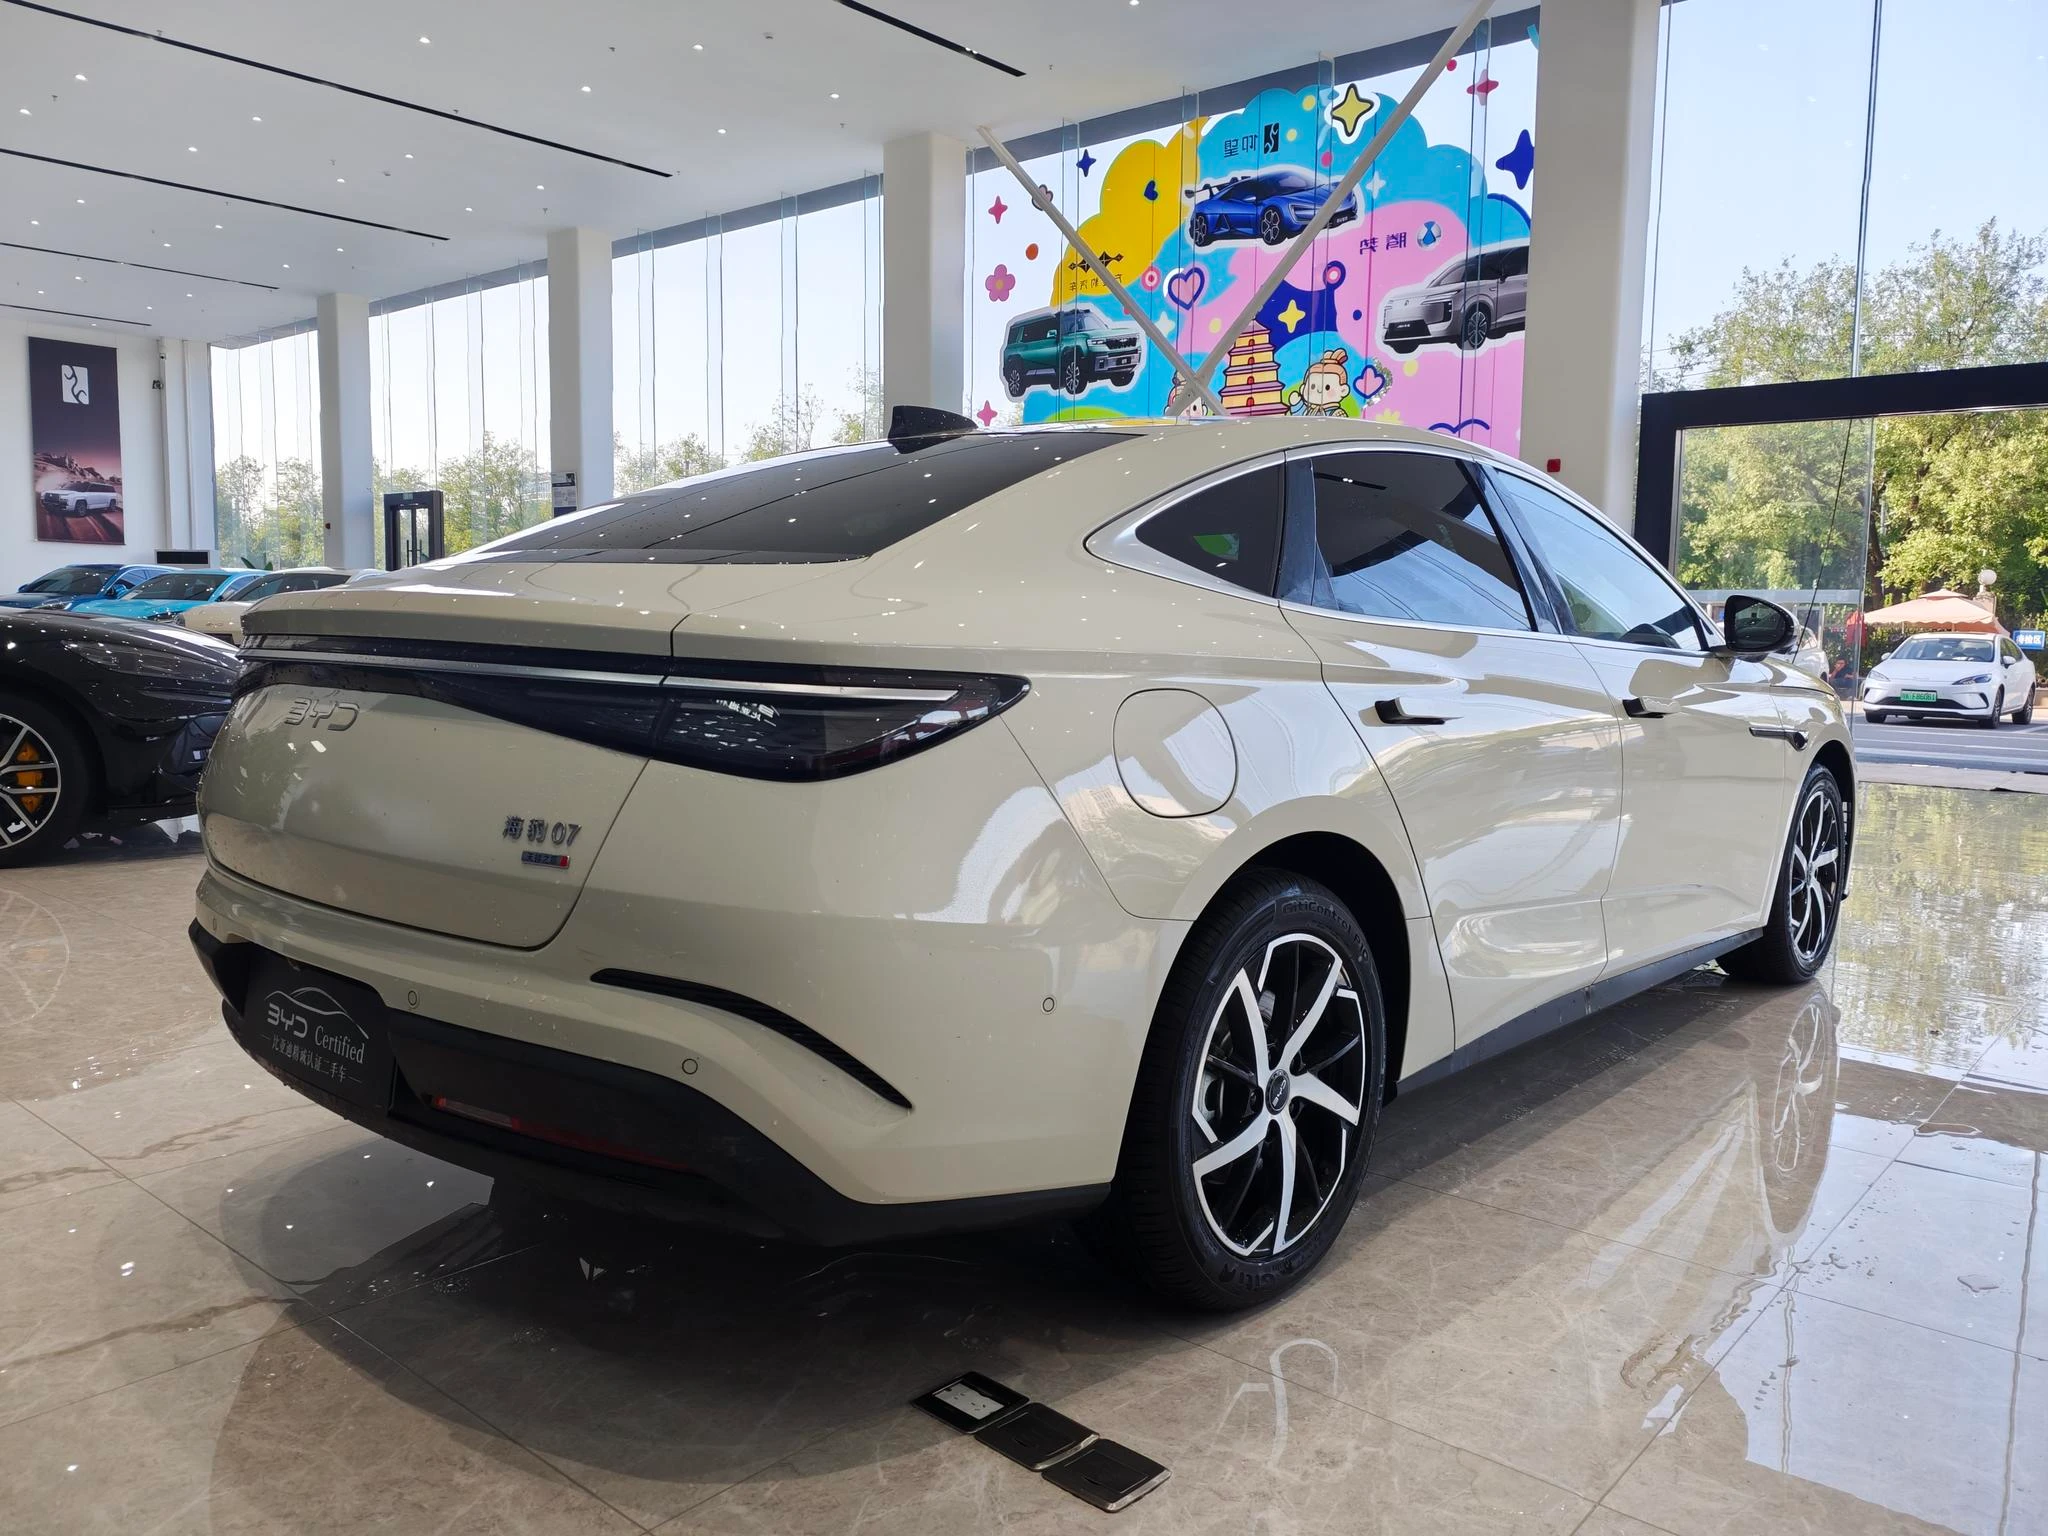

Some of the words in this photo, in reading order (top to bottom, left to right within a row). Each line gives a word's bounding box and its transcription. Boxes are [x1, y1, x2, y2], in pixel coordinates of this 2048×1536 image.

[284, 696, 360, 732] BYD
[1281, 900, 1352, 935] GitiControl
[267, 1002, 308, 1039] BYD
[314, 1025, 365, 1065] Certified
